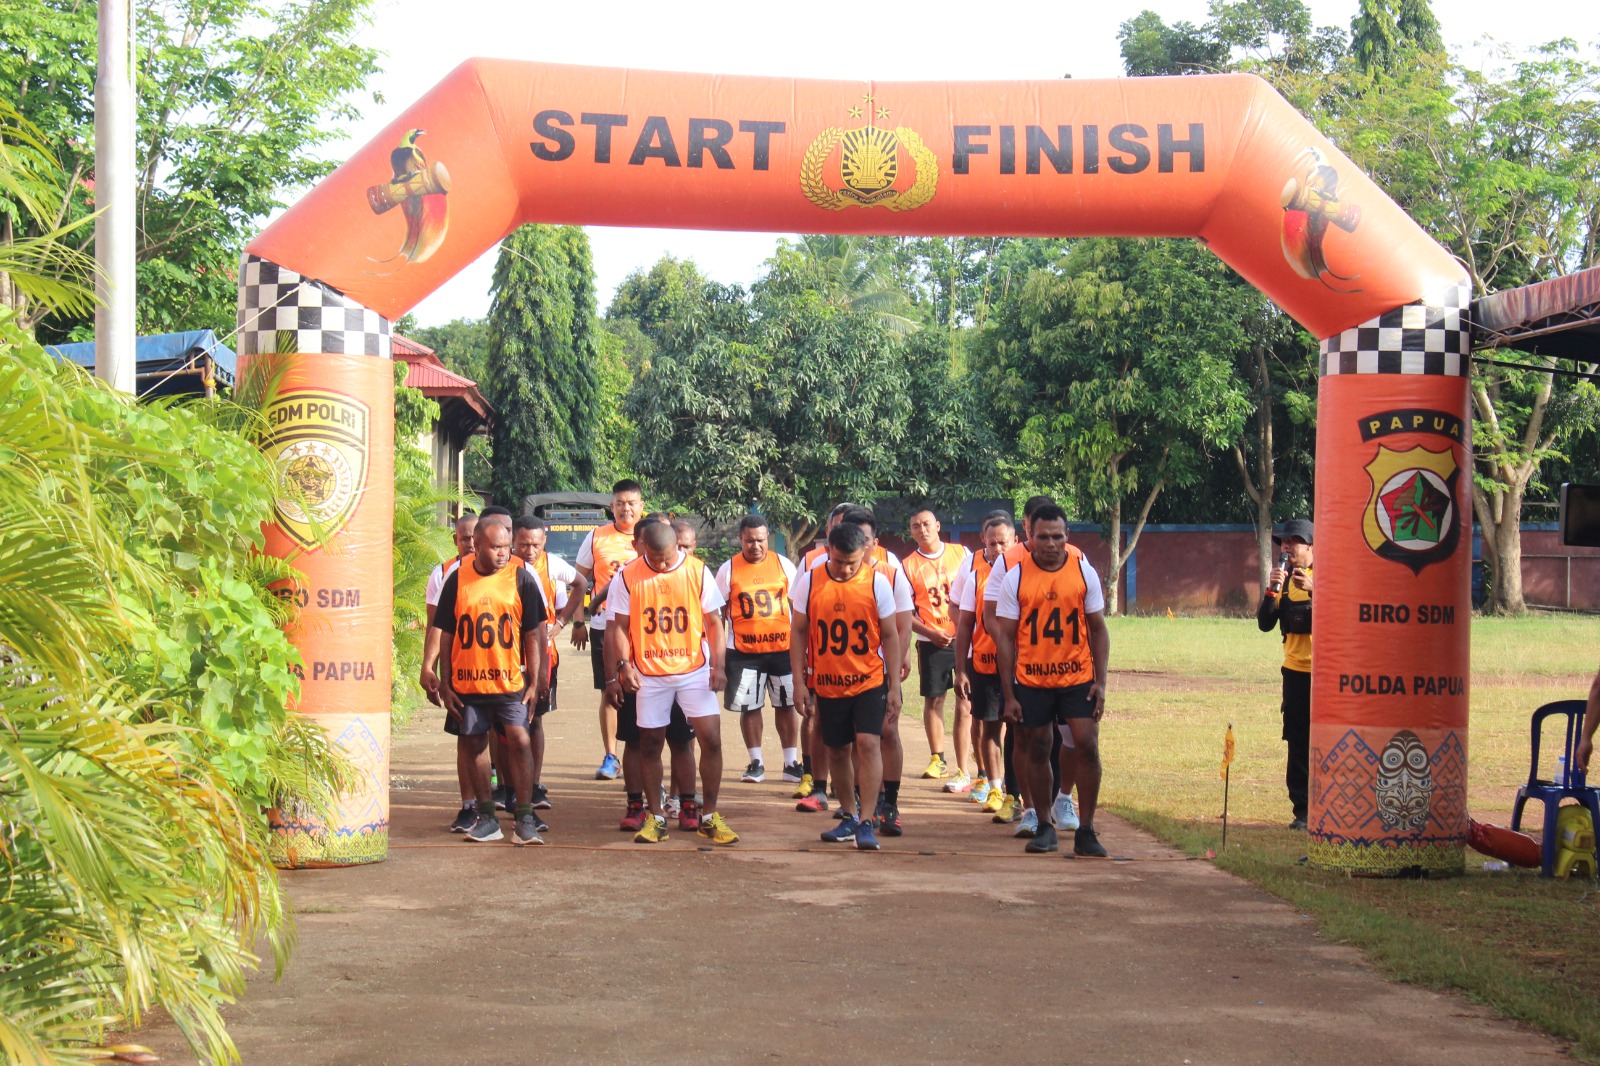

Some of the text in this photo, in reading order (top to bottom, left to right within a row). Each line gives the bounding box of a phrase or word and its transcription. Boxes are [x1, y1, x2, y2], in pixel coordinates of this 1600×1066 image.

[530, 109, 1205, 174] START FINISH
[268, 403, 303, 428] SDM
[1369, 415, 1459, 436] PAPUA
[550, 524, 572, 532] KORPS
[317, 588, 360, 608] SDM
[738, 588, 785, 619] 091
[643, 606, 688, 634] 360
[1359, 604, 1455, 625] BIRO SDM
[458, 612, 514, 650] 060
[817, 618, 869, 656] 093
[1025, 607, 1080, 646] 141
[644, 647, 691, 659] BINJASPOL
[313, 662, 375, 681] PAPUA
[457, 668, 514, 681] BINJASPOL
[1339, 674, 1465, 696] POLDA PAPUA
